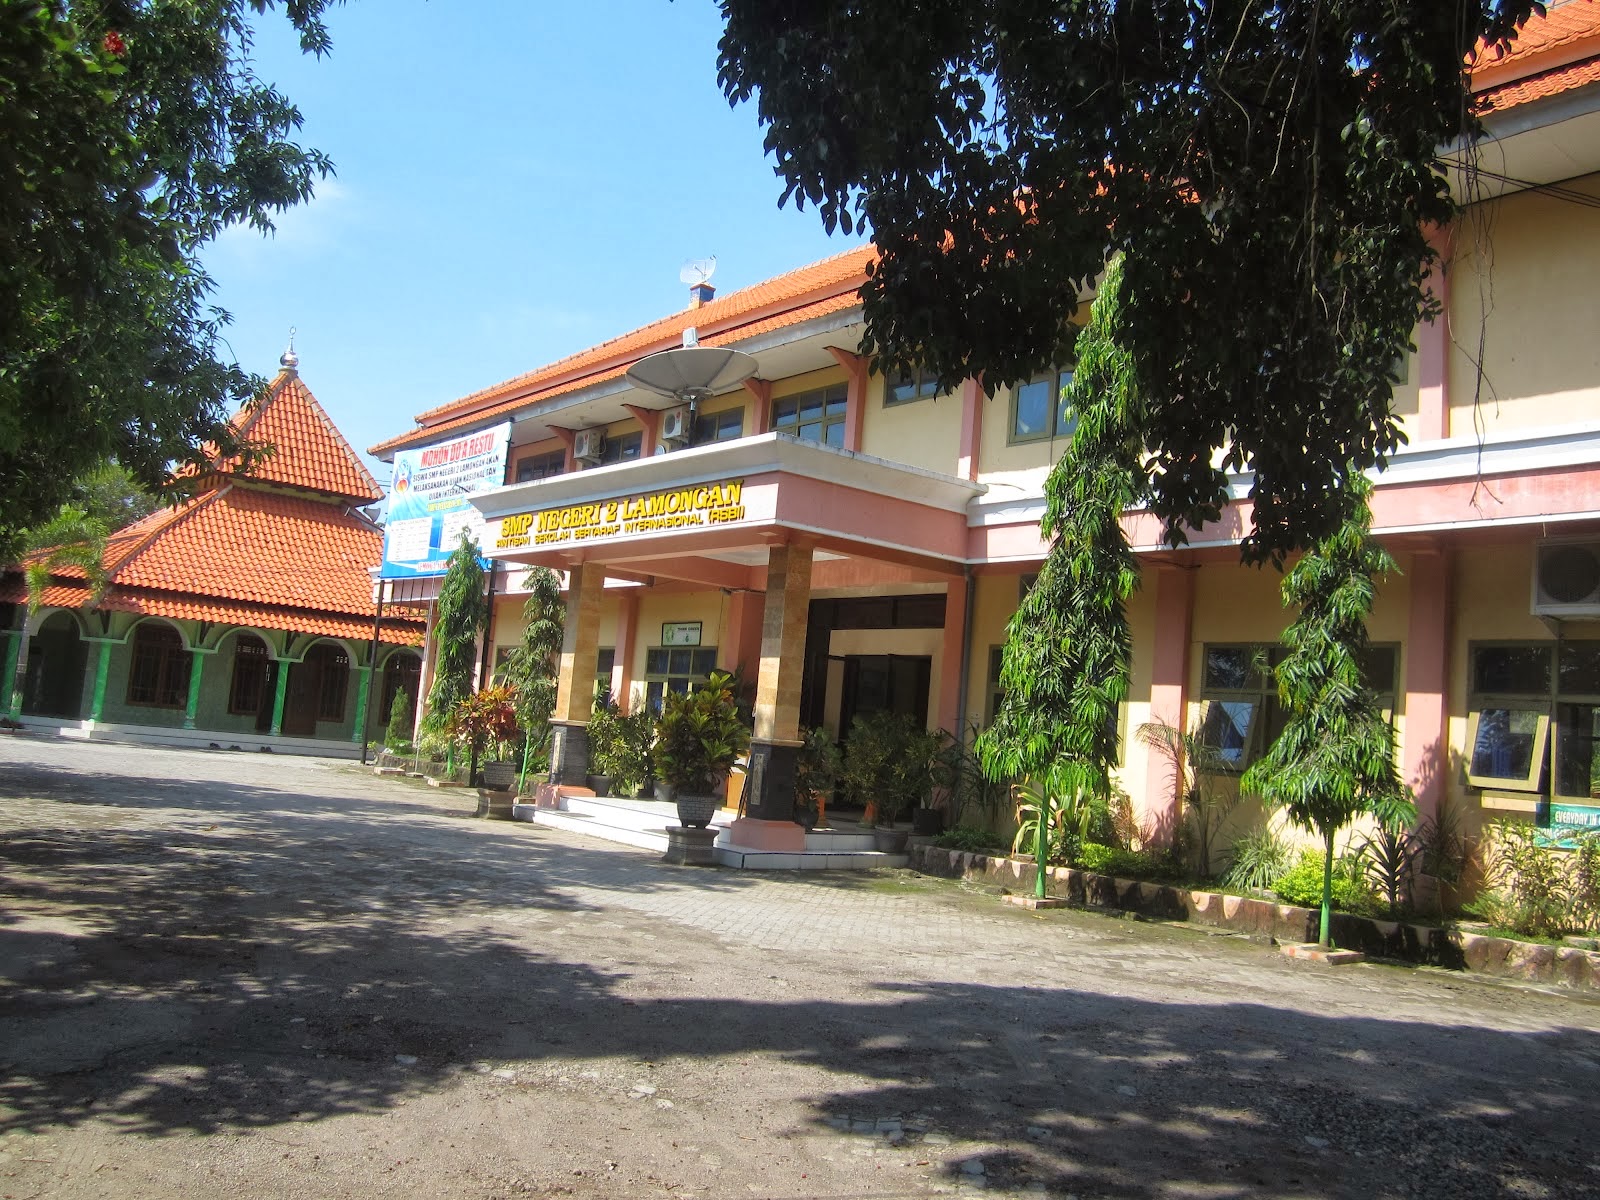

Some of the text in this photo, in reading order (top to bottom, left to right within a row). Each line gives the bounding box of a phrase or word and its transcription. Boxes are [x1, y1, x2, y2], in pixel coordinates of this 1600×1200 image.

[421, 449, 448, 468] MOHON
[469, 432, 494, 456] RESTU
[413, 471, 428, 482] SISWA
[429, 470, 438, 480] SMP
[460, 460, 485, 473] LAMONGAN
[413, 480, 448, 492] MELAKSANAKAN
[463, 471, 485, 483] NASIONAL
[501, 513, 533, 537] SMP
[536, 502, 602, 532] NEGERI
[606, 501, 618, 522] 2
[622, 480, 743, 520] LAMONGAN
[496, 505, 745, 548] RINTISAN SEKOLAH BERTARAF INTERNASIONAL (RSBI)
[1555, 810, 1587, 825] EVERYDAY
